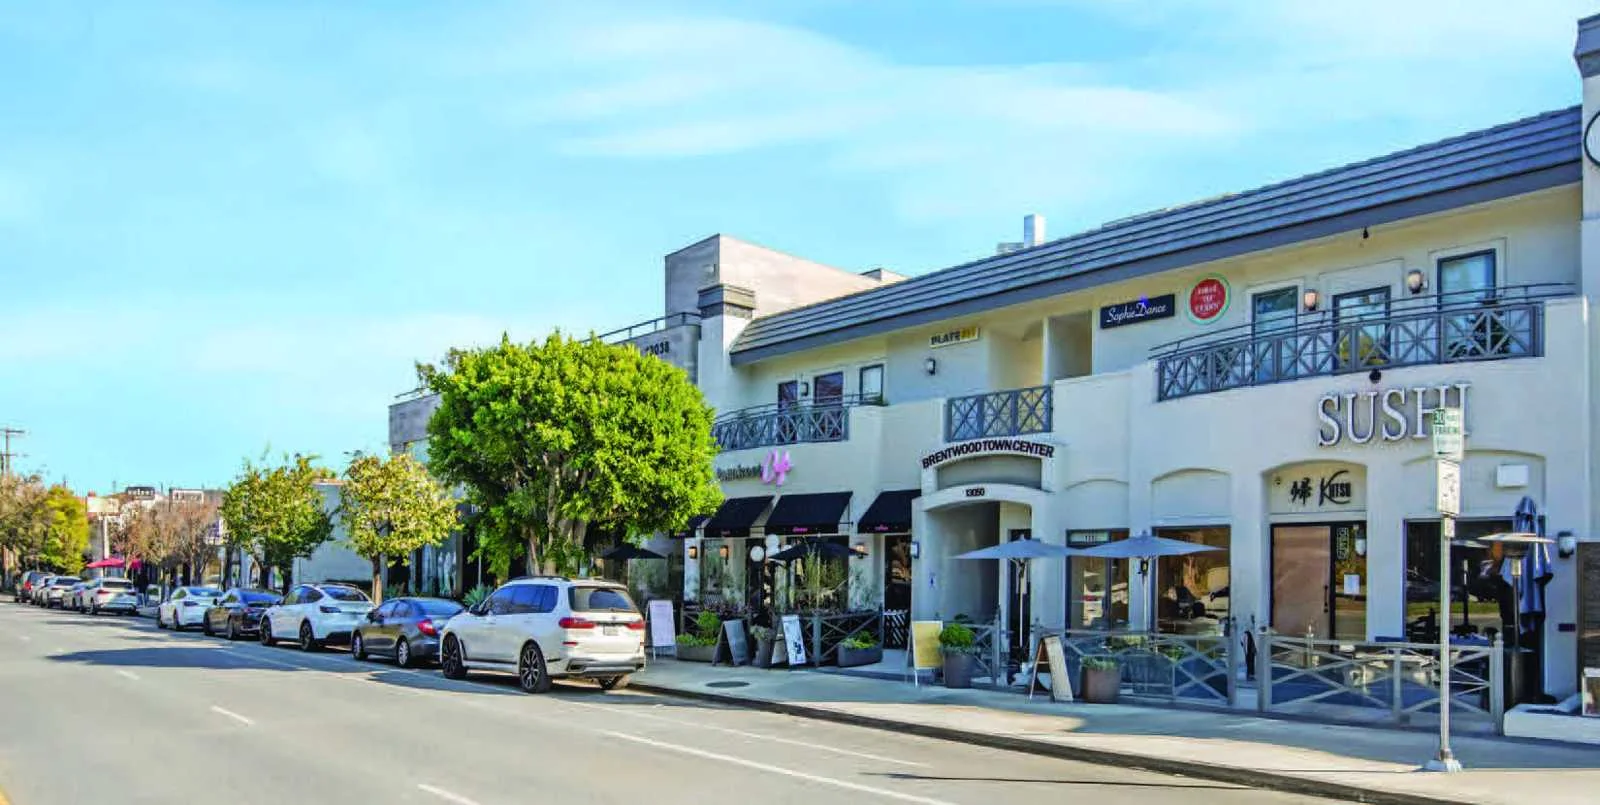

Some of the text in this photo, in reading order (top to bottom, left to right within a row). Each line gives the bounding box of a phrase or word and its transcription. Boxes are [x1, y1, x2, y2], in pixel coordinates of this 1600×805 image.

[1106, 302, 1166, 322] Sophie Dance
[1318, 383, 1471, 446] SUSHI
[922, 440, 1055, 469] BRENTWOOD TOWN CENTER
[966, 488, 985, 497] 13050
